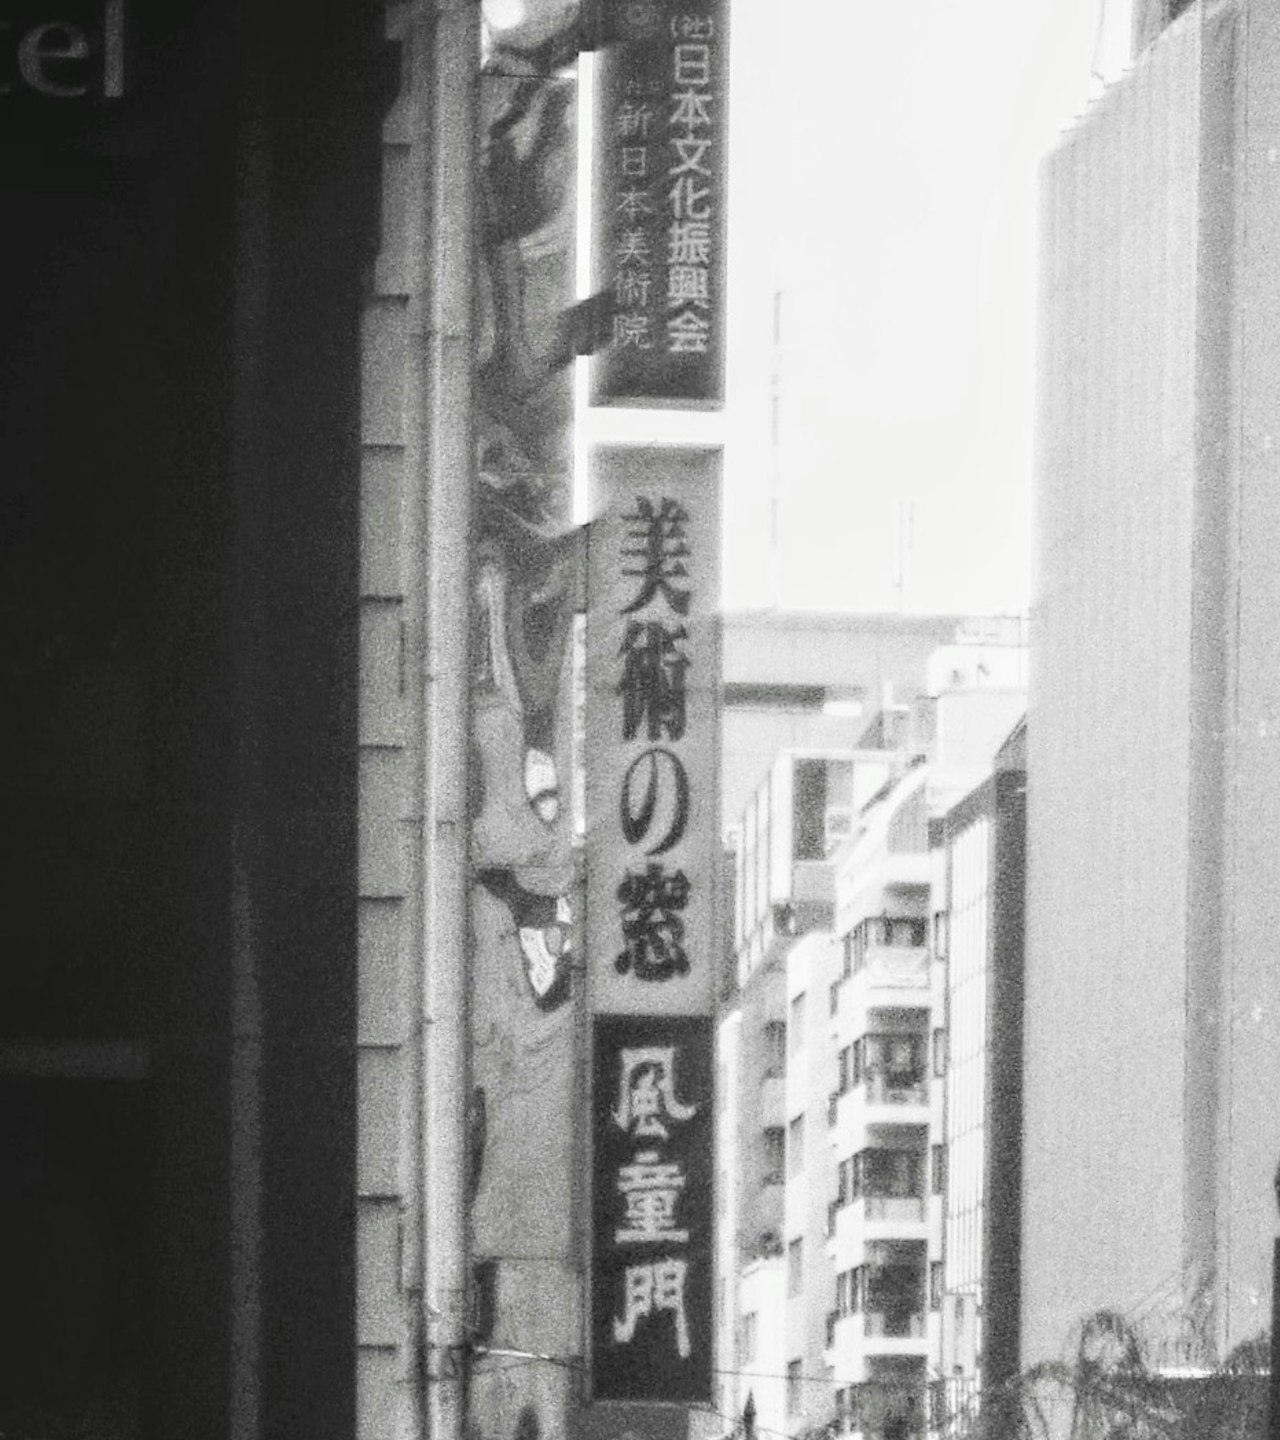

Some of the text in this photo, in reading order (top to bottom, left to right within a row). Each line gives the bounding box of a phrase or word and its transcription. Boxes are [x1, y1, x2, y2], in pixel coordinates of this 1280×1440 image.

[0, 0, 125, 98] el
[614, 496, 693, 983] 美術の窓
[612, 1044, 696, 1361] 風童門
